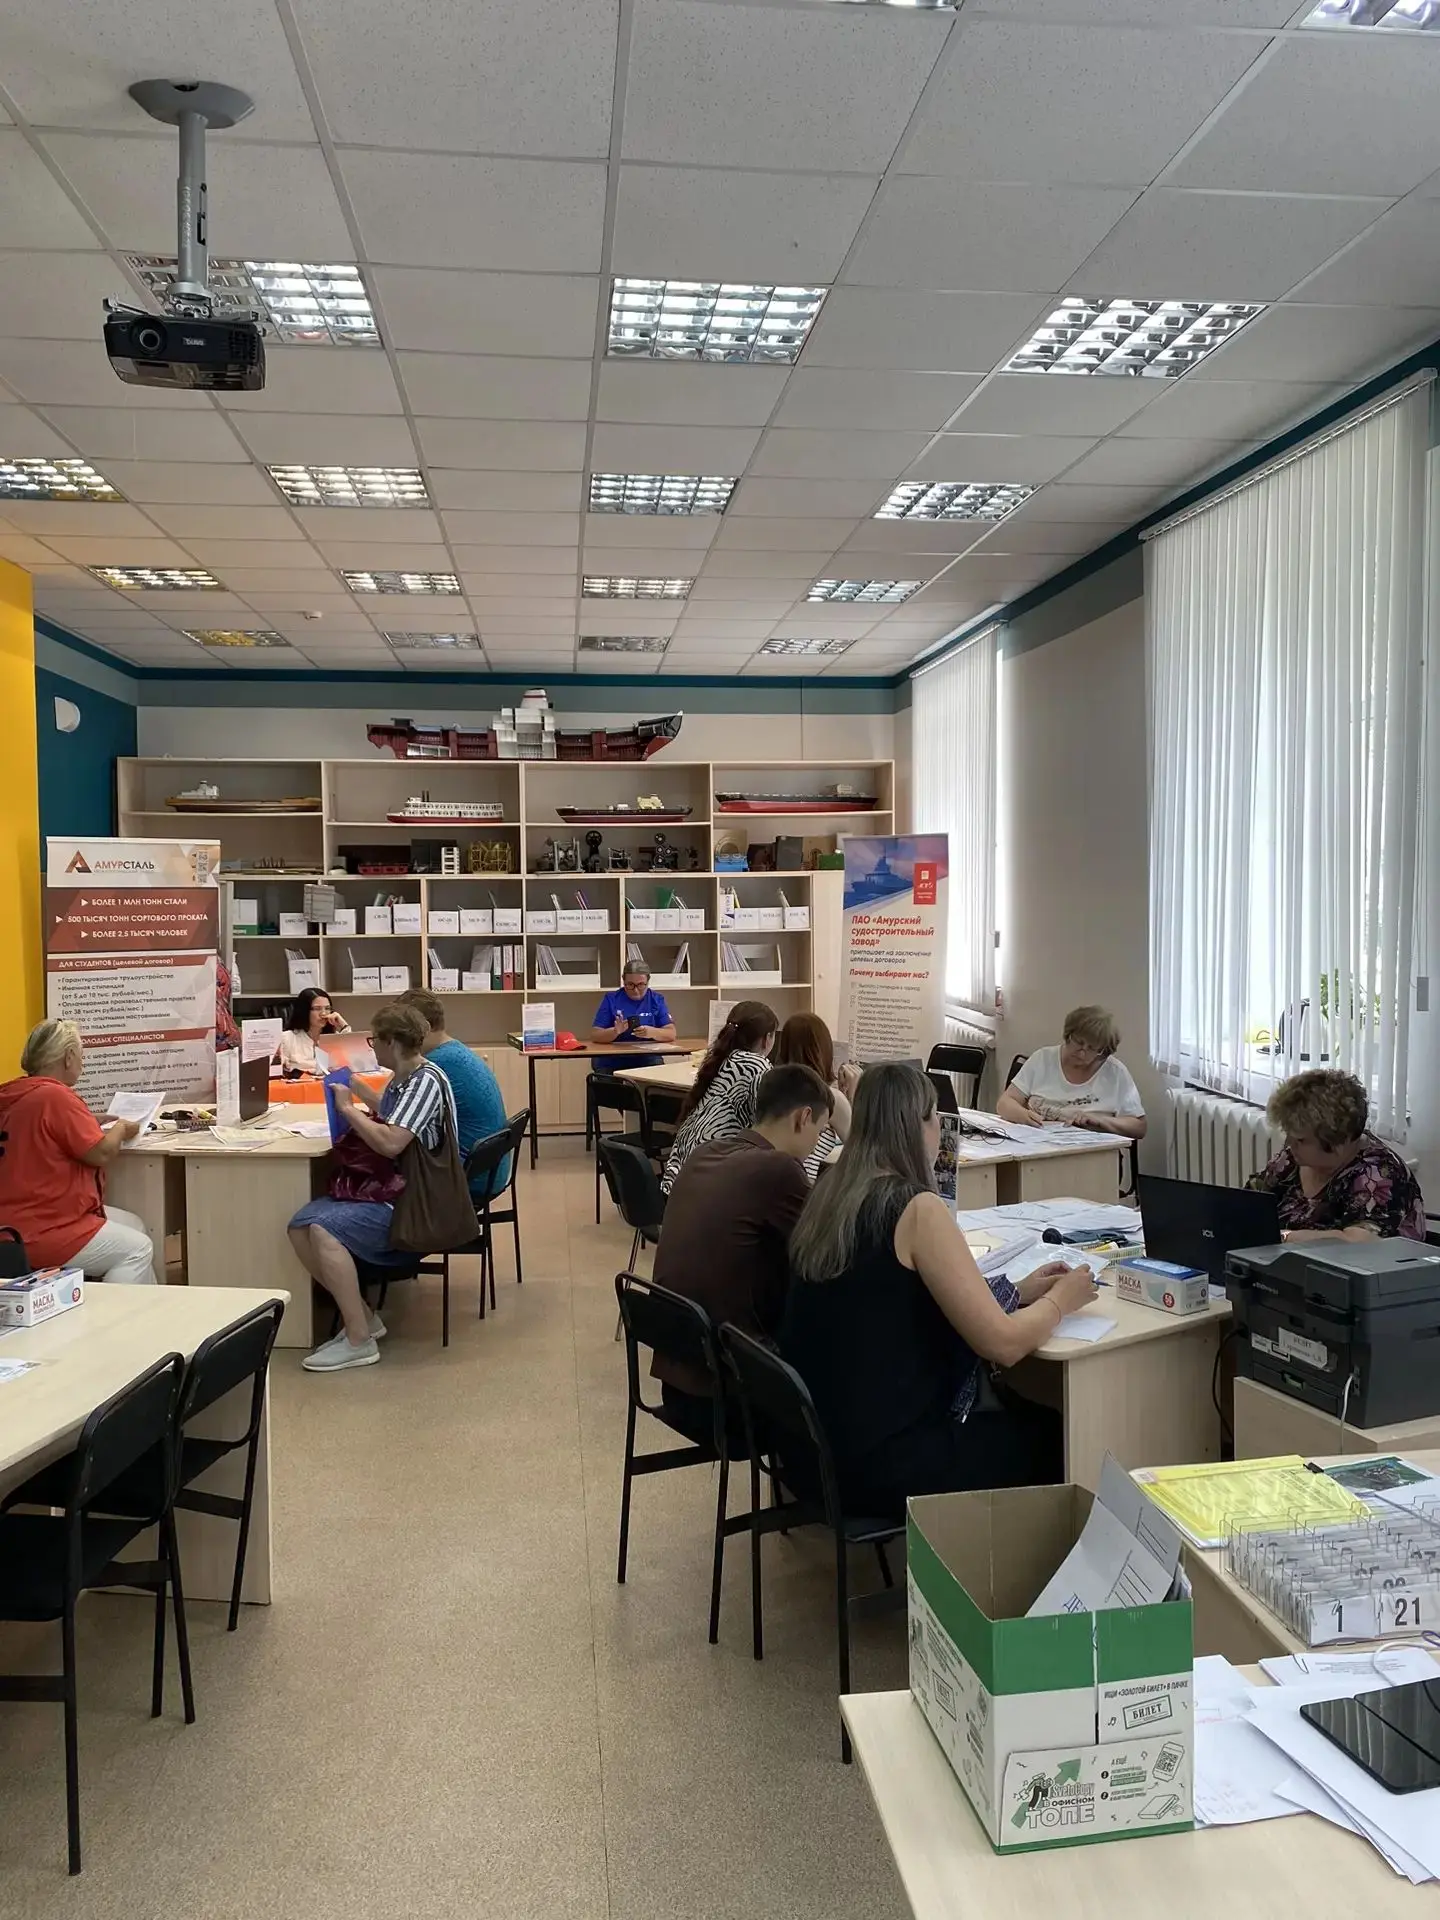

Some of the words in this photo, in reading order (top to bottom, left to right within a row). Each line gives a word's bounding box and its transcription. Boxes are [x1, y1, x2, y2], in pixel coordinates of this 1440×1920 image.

[94, 860, 155, 870] АМУРСТАЛЬ
[91, 898, 117, 906] БОЛЕЕ
[67, 915, 82, 923] 500
[130, 914, 177, 922] СОРТОВОГО
[851, 915, 871, 925] ПАО
[872, 915, 922, 926] «Амурский
[92, 930, 117, 938] БОЛЕЕ
[156, 929, 188, 937] ЧЕЛОВЕК
[851, 926, 934, 937] судостроительный
[59, 960, 74, 968] ДЛЯ
[74, 959, 112, 968] СТУДЕНТОВ
[143, 957, 174, 967] договор)
[80, 1037, 111, 1045] ОЛОДЫХ
[112, 1033, 165, 1043] СПЕЦИАЛИСТОВ
[1118, 1274, 1142, 1289] МАСКА
[32, 1292, 55, 1310] МАСКА
[1394, 1596, 1421, 1627] 21
[1337, 1604, 1343, 1633] 1
[1166, 1683, 1171, 1691] В
[1132, 1703, 1162, 1720] БИЛЕТ
[1051, 1796, 1095, 1807] ОФИСНОМ
[1025, 1803, 1095, 1829] ТОПЕ
